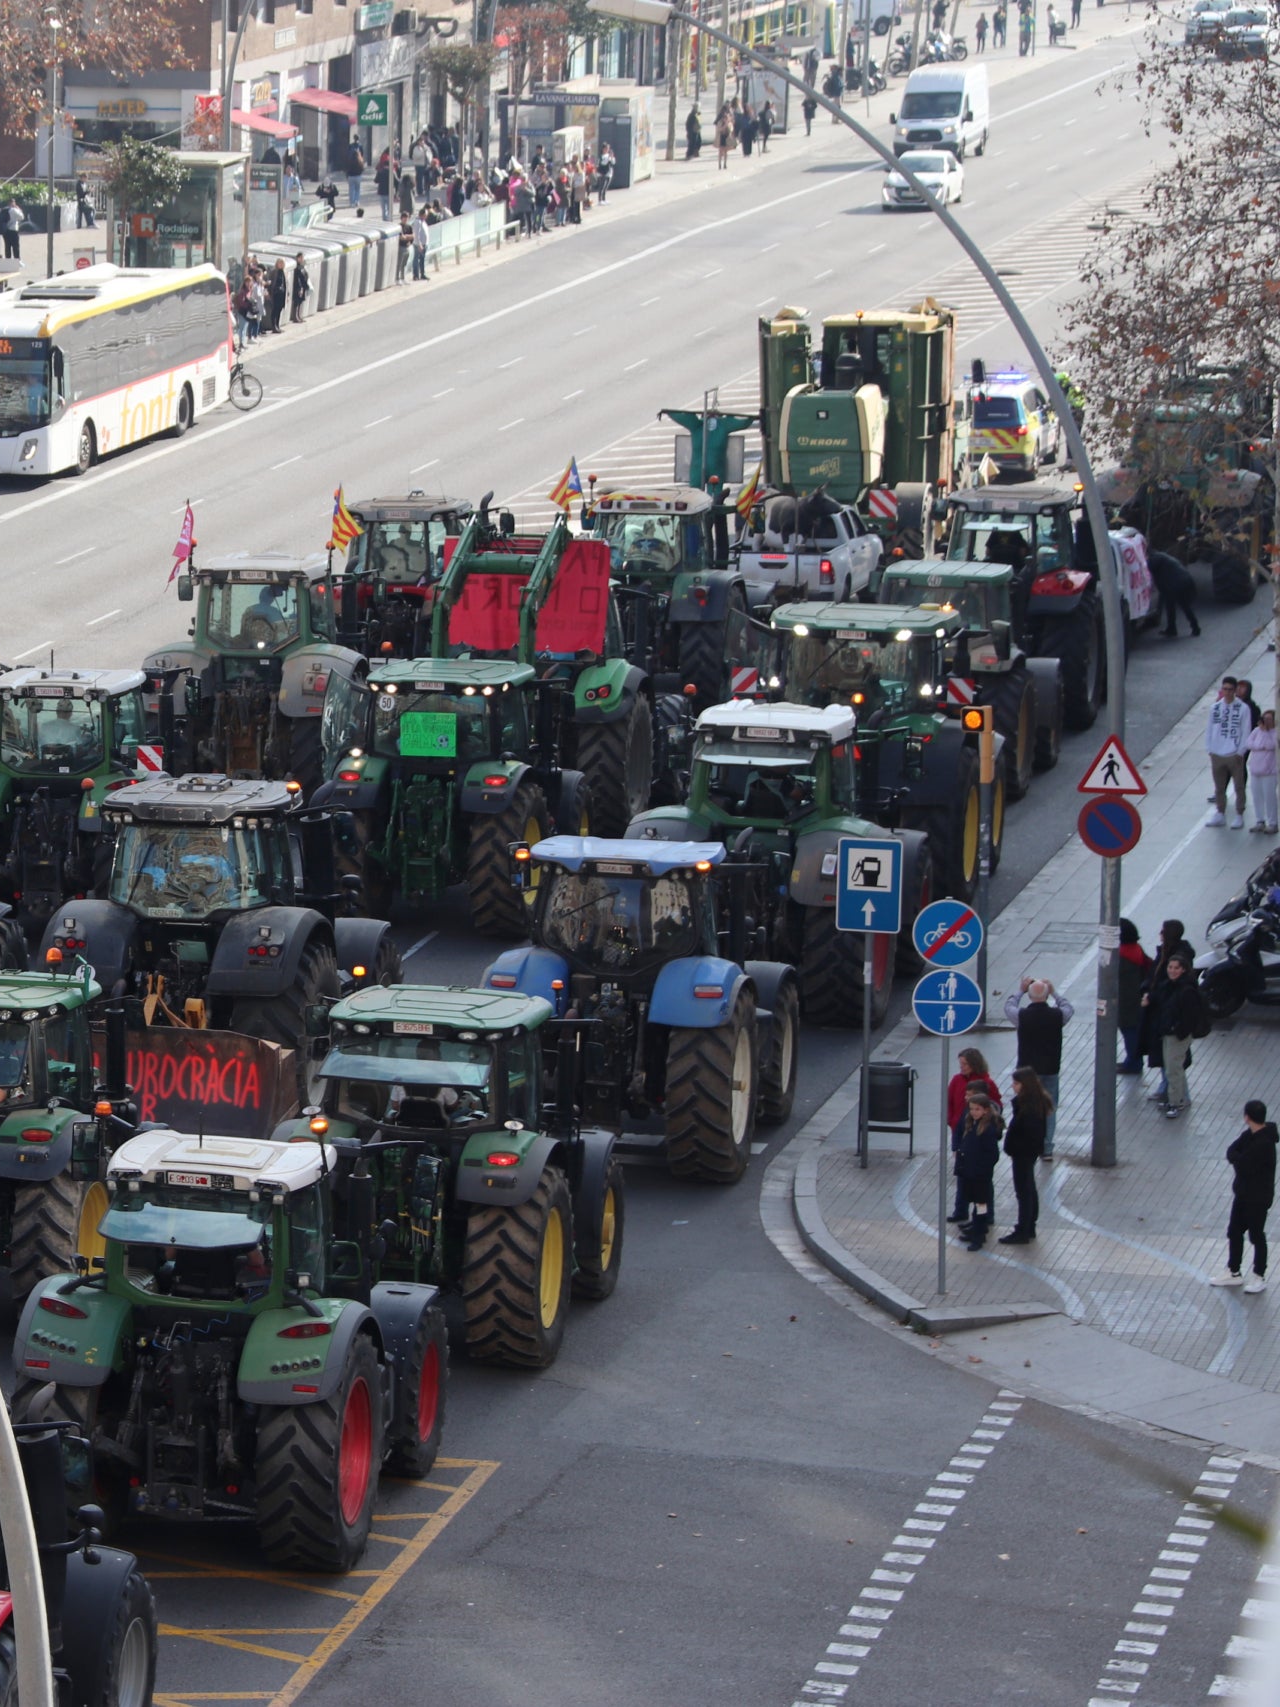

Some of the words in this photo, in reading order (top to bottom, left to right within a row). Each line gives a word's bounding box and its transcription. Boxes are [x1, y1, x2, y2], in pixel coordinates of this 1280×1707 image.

[546, 95, 598, 104] VANGUARDIA
[361, 112, 384, 121] adif
[141, 217, 154, 232] R
[157, 223, 200, 233] Rodalies
[120, 372, 176, 447] font
[810, 438, 848, 446] KRONE
[381, 697, 392, 709] 50
